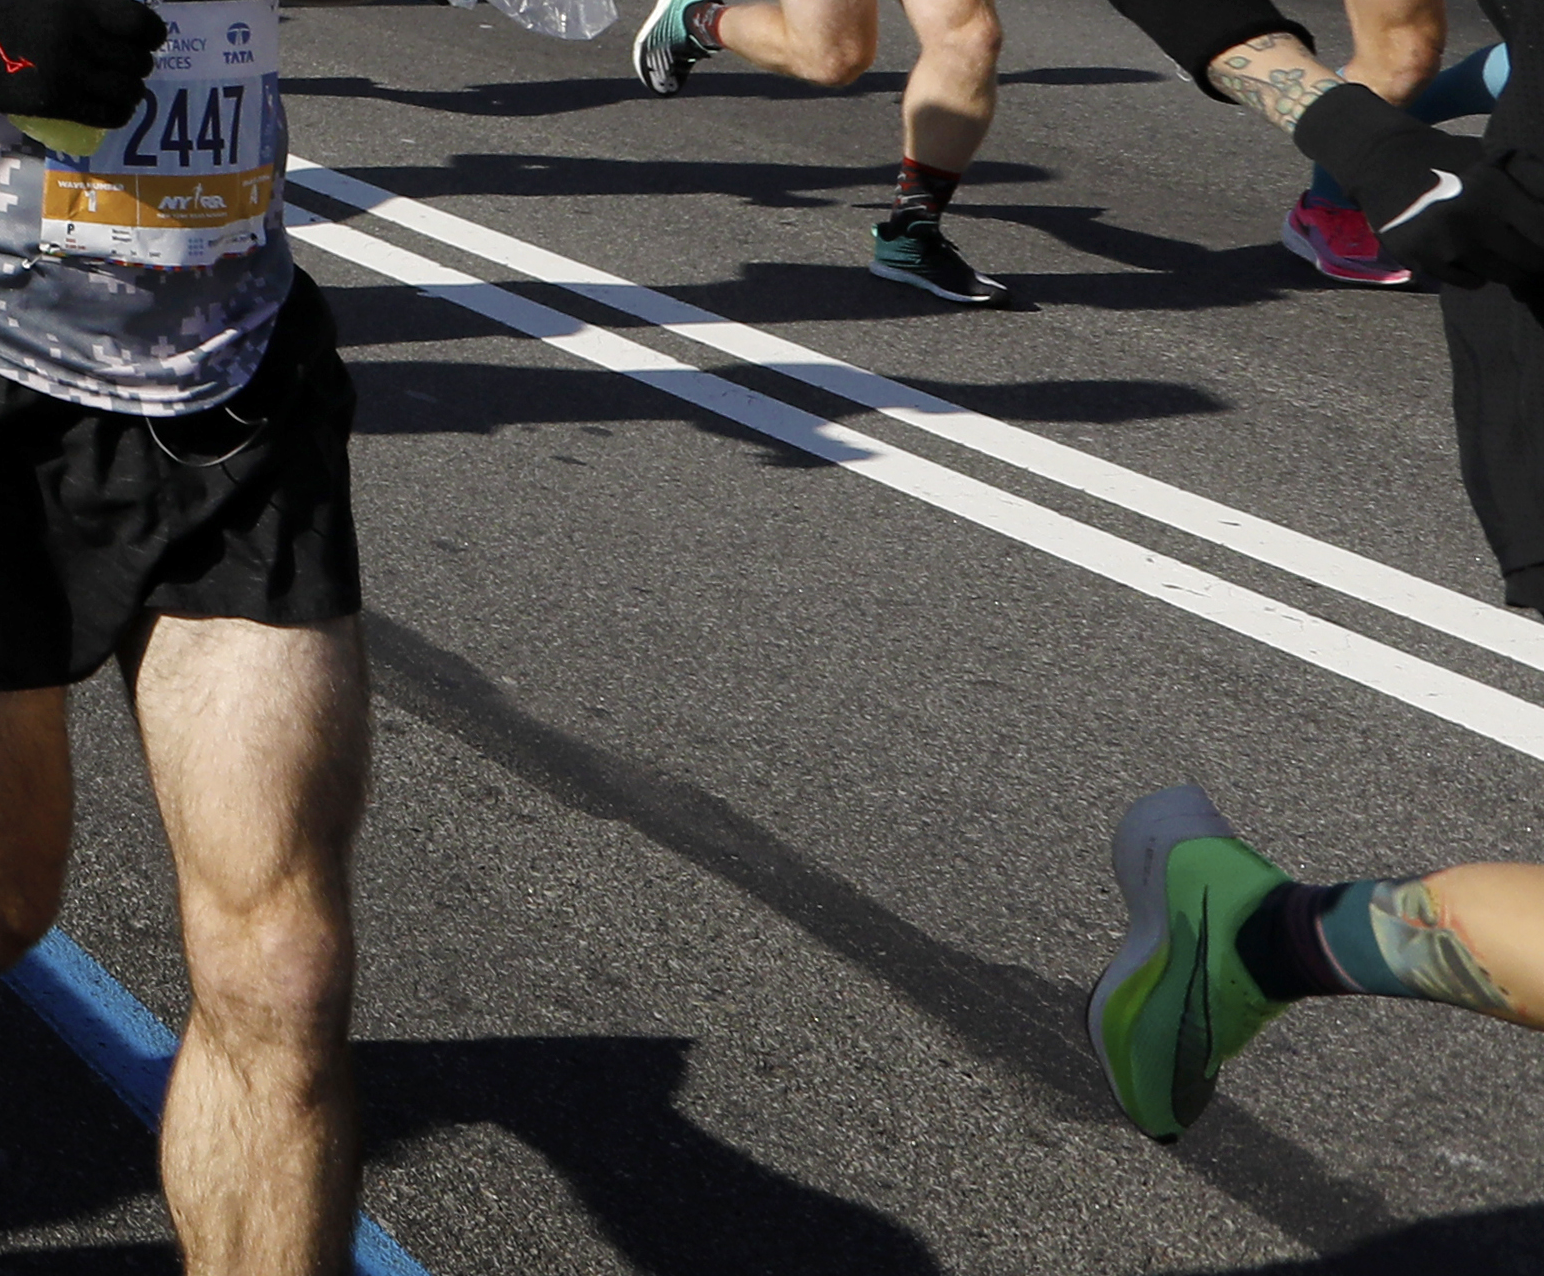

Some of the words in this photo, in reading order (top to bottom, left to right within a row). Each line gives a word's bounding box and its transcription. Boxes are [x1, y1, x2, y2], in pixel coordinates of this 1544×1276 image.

[223, 51, 255, 64] TATA
[123, 85, 245, 167] 2447
[58, 179, 86, 190] WAVE
[84, 190, 98, 212] 1
[67, 223, 75, 235] P
